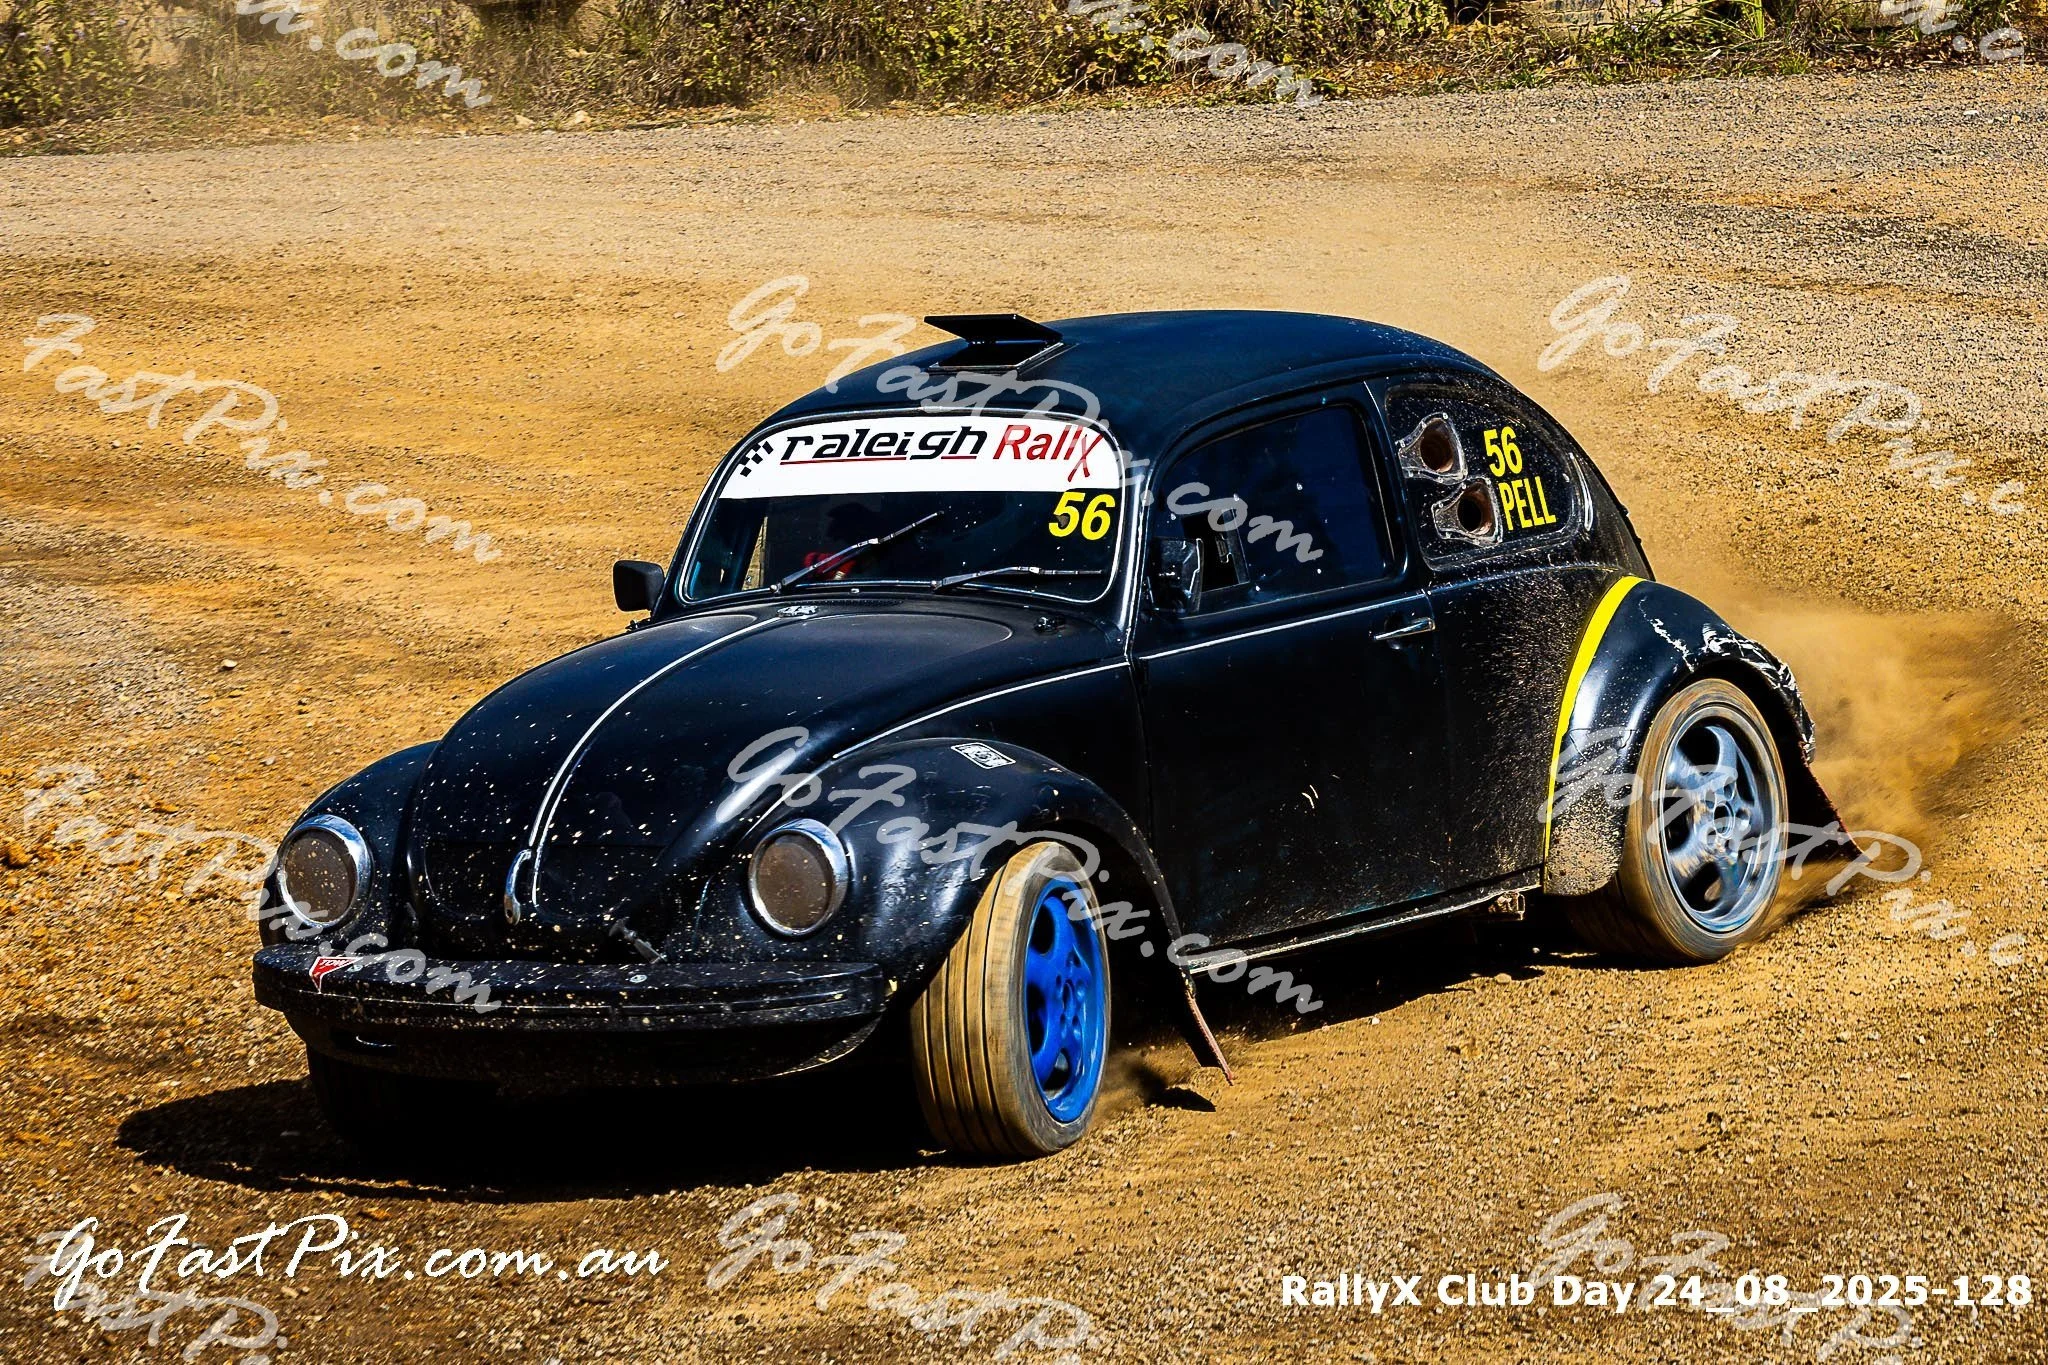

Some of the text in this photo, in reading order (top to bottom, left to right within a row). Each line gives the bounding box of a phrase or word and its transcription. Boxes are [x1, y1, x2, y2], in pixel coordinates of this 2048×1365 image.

[781, 426, 988, 462] raleigh
[1484, 426, 1523, 477] 56
[1048, 491, 1116, 541] 56
[1498, 476, 1557, 531] PELL
